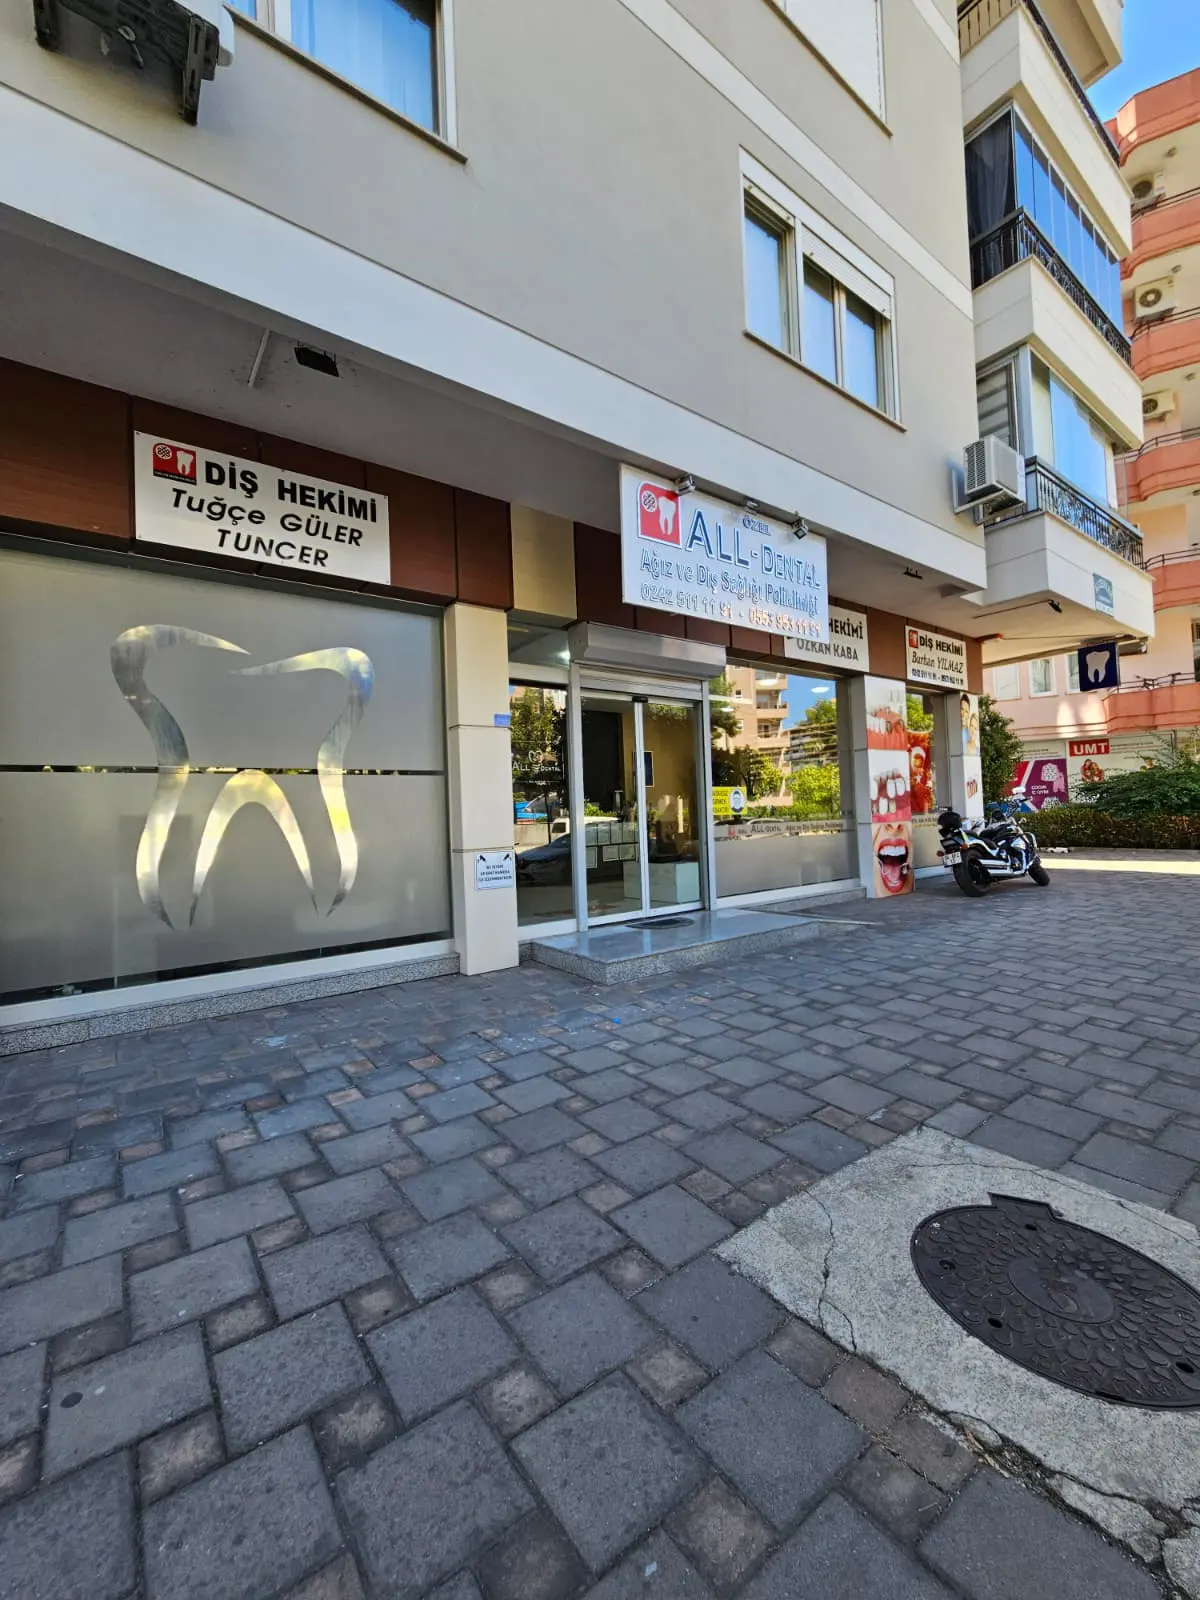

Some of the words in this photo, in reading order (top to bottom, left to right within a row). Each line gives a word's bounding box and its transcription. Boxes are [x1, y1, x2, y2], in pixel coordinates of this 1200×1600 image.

[205, 460, 259, 499] DİŞ
[277, 478, 377, 523] HEKİMİ
[171, 487, 266, 526] Tuğçe
[280, 513, 363, 547] GÜLER
[217, 528, 329, 568] TUNCER
[639, 582, 674, 606] 0242
[677, 590, 698, 614] 511
[640, 549, 673, 580] Ağız
[676, 563, 694, 583] ve
[697, 562, 718, 593] Diş
[721, 571, 763, 605] Sağlığı
[765, 582, 819, 618] Polikliniği
[833, 643, 859, 661] KABA
[919, 634, 933, 652] DİŞ
[935, 639, 963, 657] HEKİMİ
[936, 656, 964, 673] YILMAZ
[1073, 742, 1108, 755] UMT
